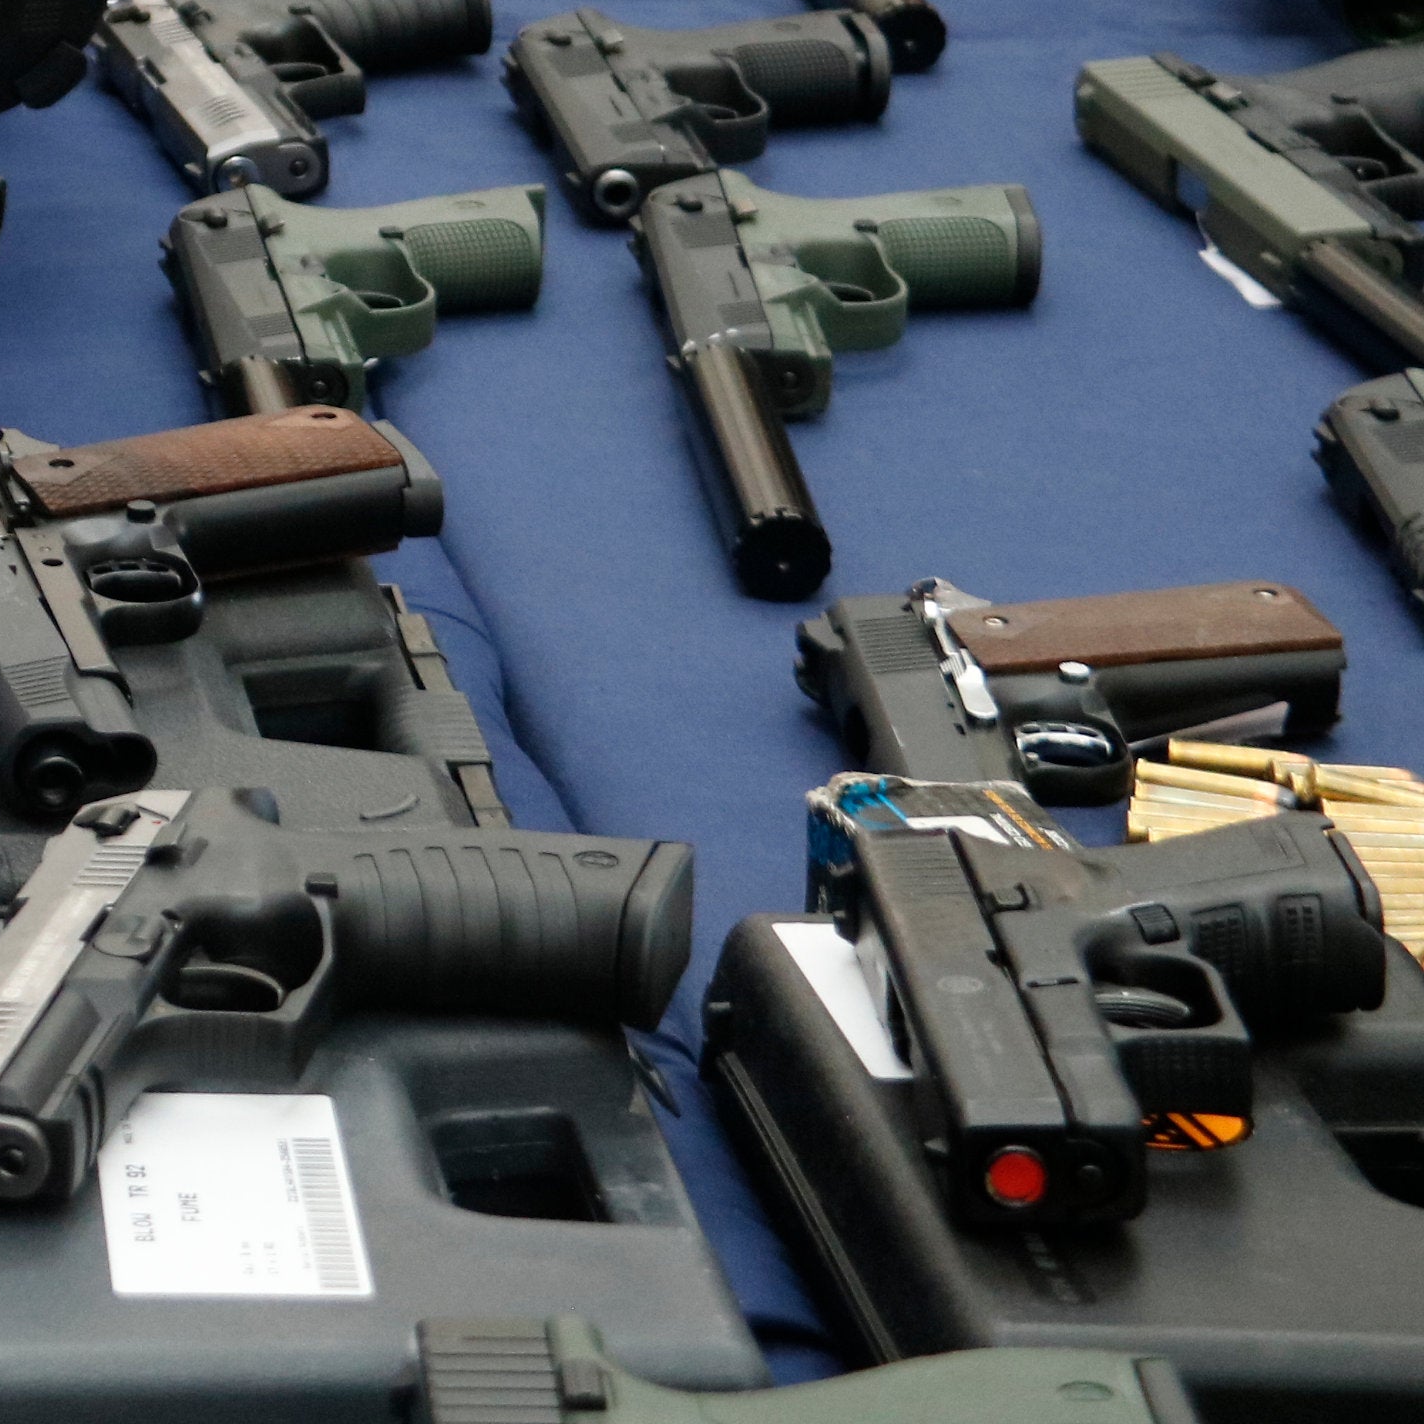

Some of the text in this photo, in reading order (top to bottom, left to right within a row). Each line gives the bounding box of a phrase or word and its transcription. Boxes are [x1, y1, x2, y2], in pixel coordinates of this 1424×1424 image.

[125, 1163, 147, 1179] 92
[128, 1185, 149, 1198] TR
[177, 1191, 202, 1223] FUME
[132, 1212, 156, 1243] BLOW
